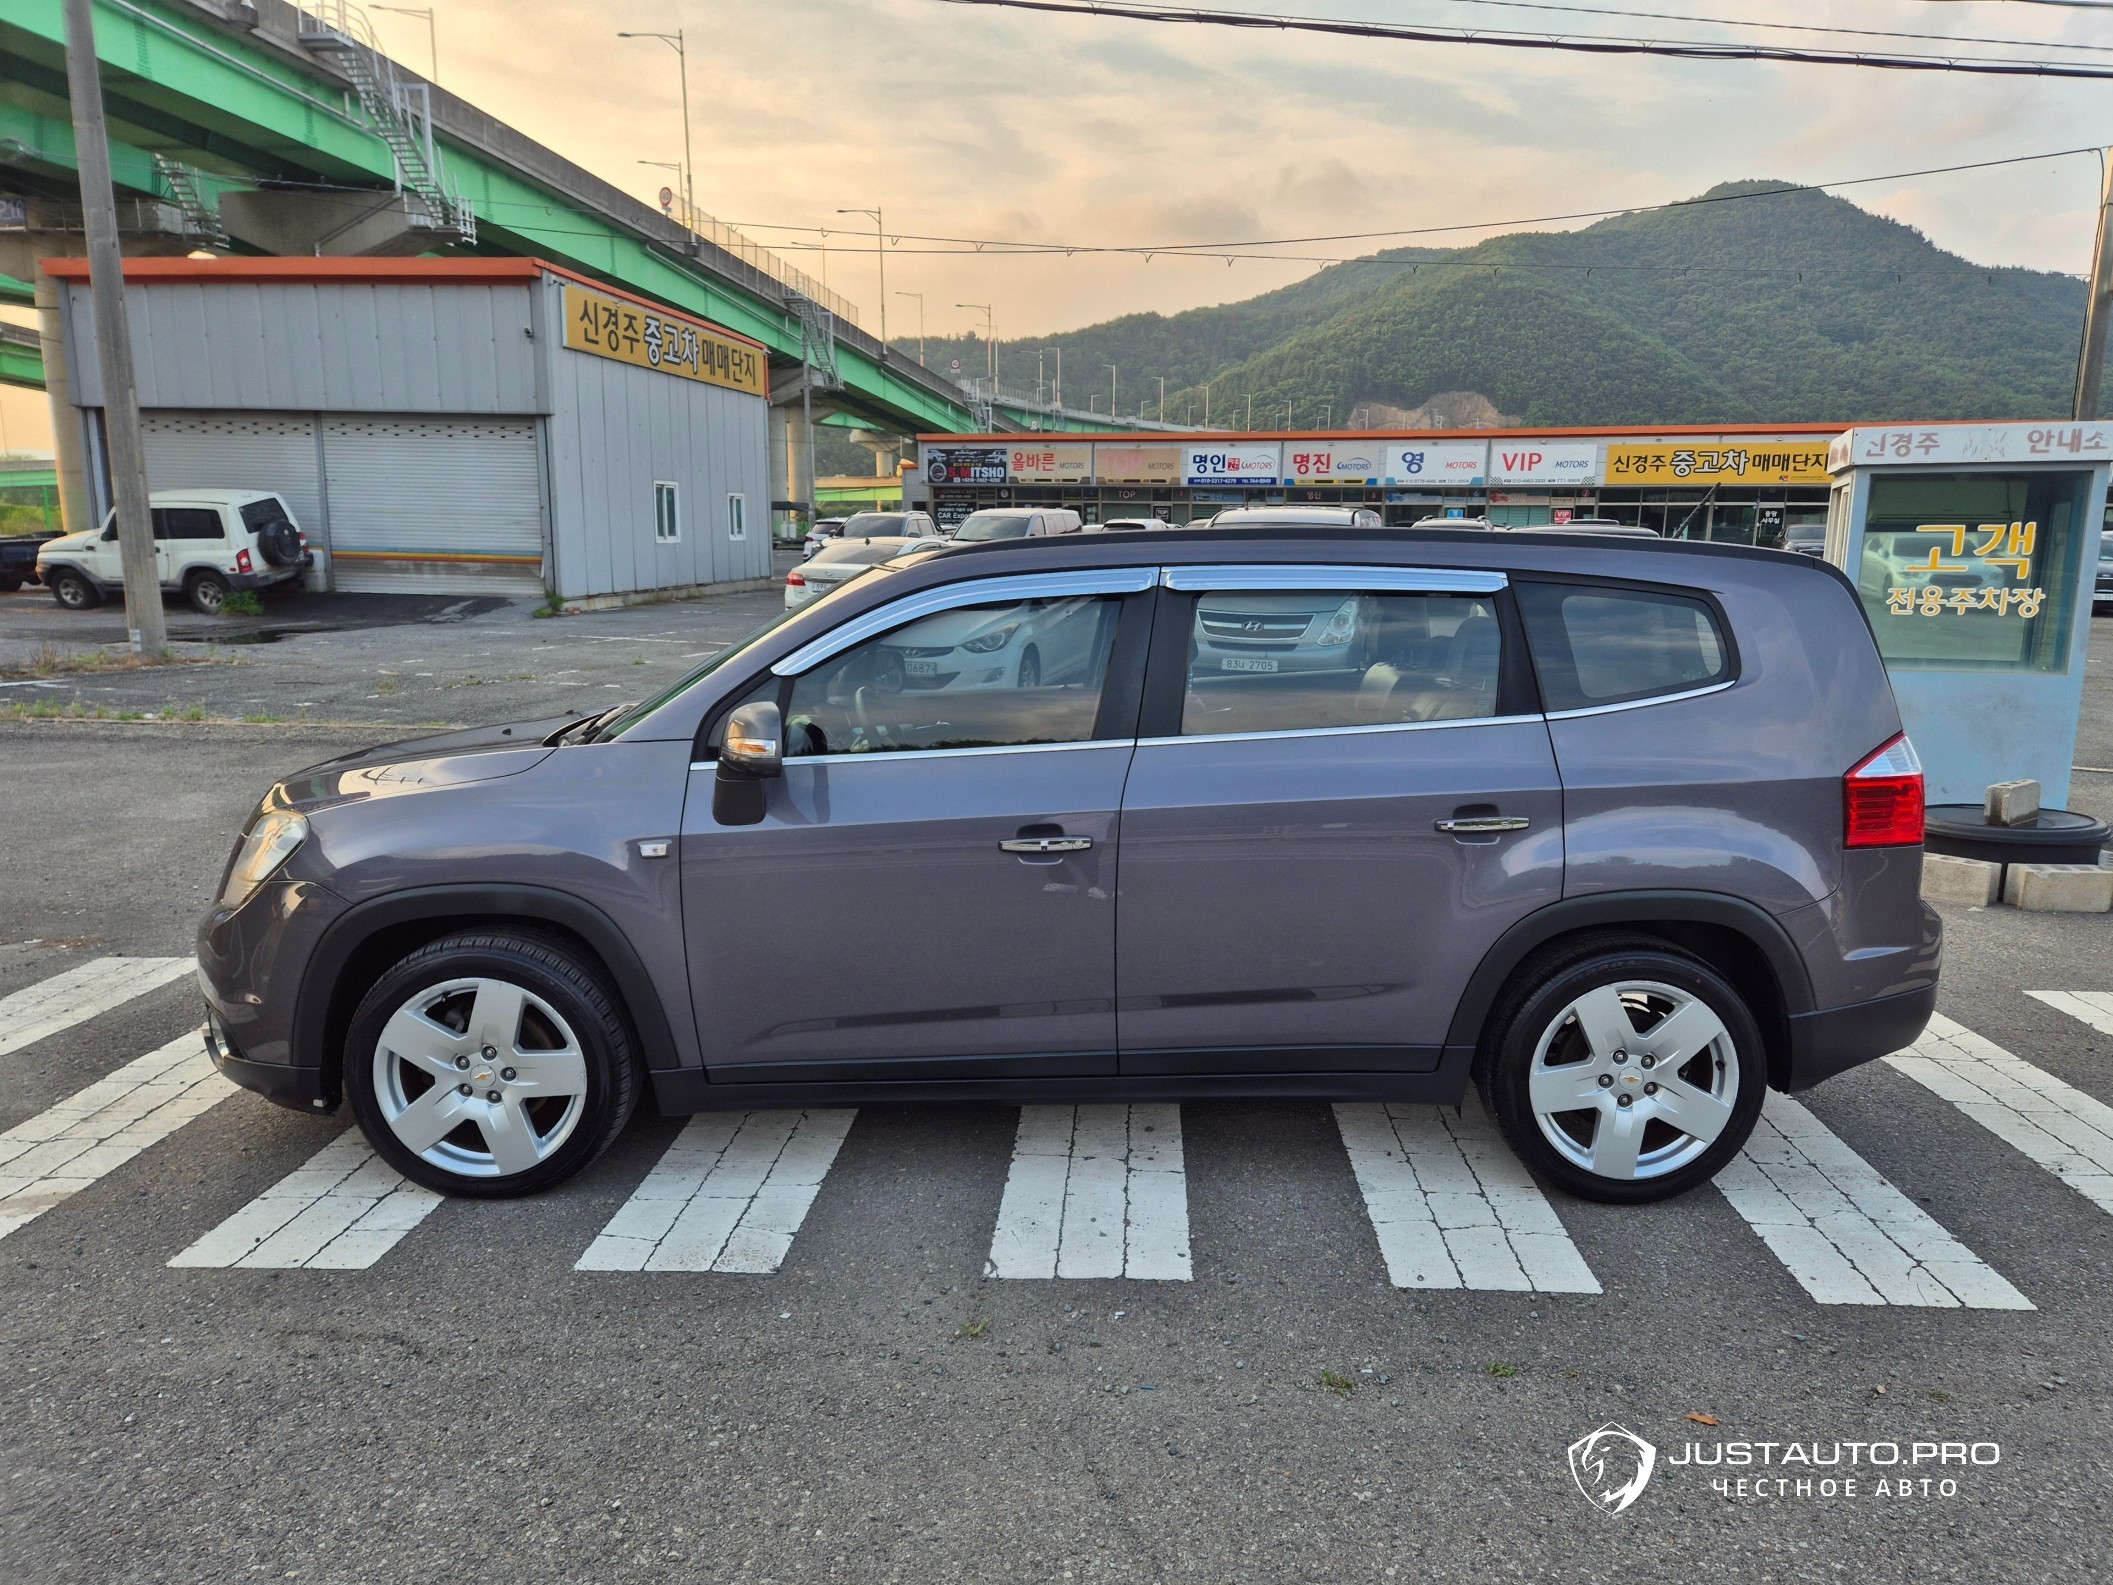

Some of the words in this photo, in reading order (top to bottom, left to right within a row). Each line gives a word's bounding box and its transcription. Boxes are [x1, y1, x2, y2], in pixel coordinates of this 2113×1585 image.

[579, 299, 641, 354] 신경주
[643, 314, 700, 375] 중고차
[701, 338, 756, 387] 매매단지
[1865, 432, 1941, 458] 신경주
[2026, 428, 2108, 454] 안내소
[1011, 452, 1056, 472] 올바른
[1058, 461, 1085, 470] MOTORS
[1147, 462, 1175, 470] MOTORS
[1192, 454, 1226, 474] 명인
[1244, 462, 1274, 470] MOTORS
[1293, 453, 1331, 475] 명진
[1401, 452, 1425, 474] 영
[1445, 461, 1478, 469] MOTORS
[1502, 452, 1543, 472] VIP
[1554, 460, 1590, 469] MOTORS
[1612, 455, 1667, 474] 신경주
[1669, 449, 1750, 478] 중고차
[1752, 453, 1828, 472] 매매단지
[1118, 490, 1136, 498] TOP
[1904, 521, 2037, 580] 고객
[1886, 585, 2047, 619] 전용주차장
[906, 663, 931, 673] 0687
[1249, 660, 1273, 671] 2705
